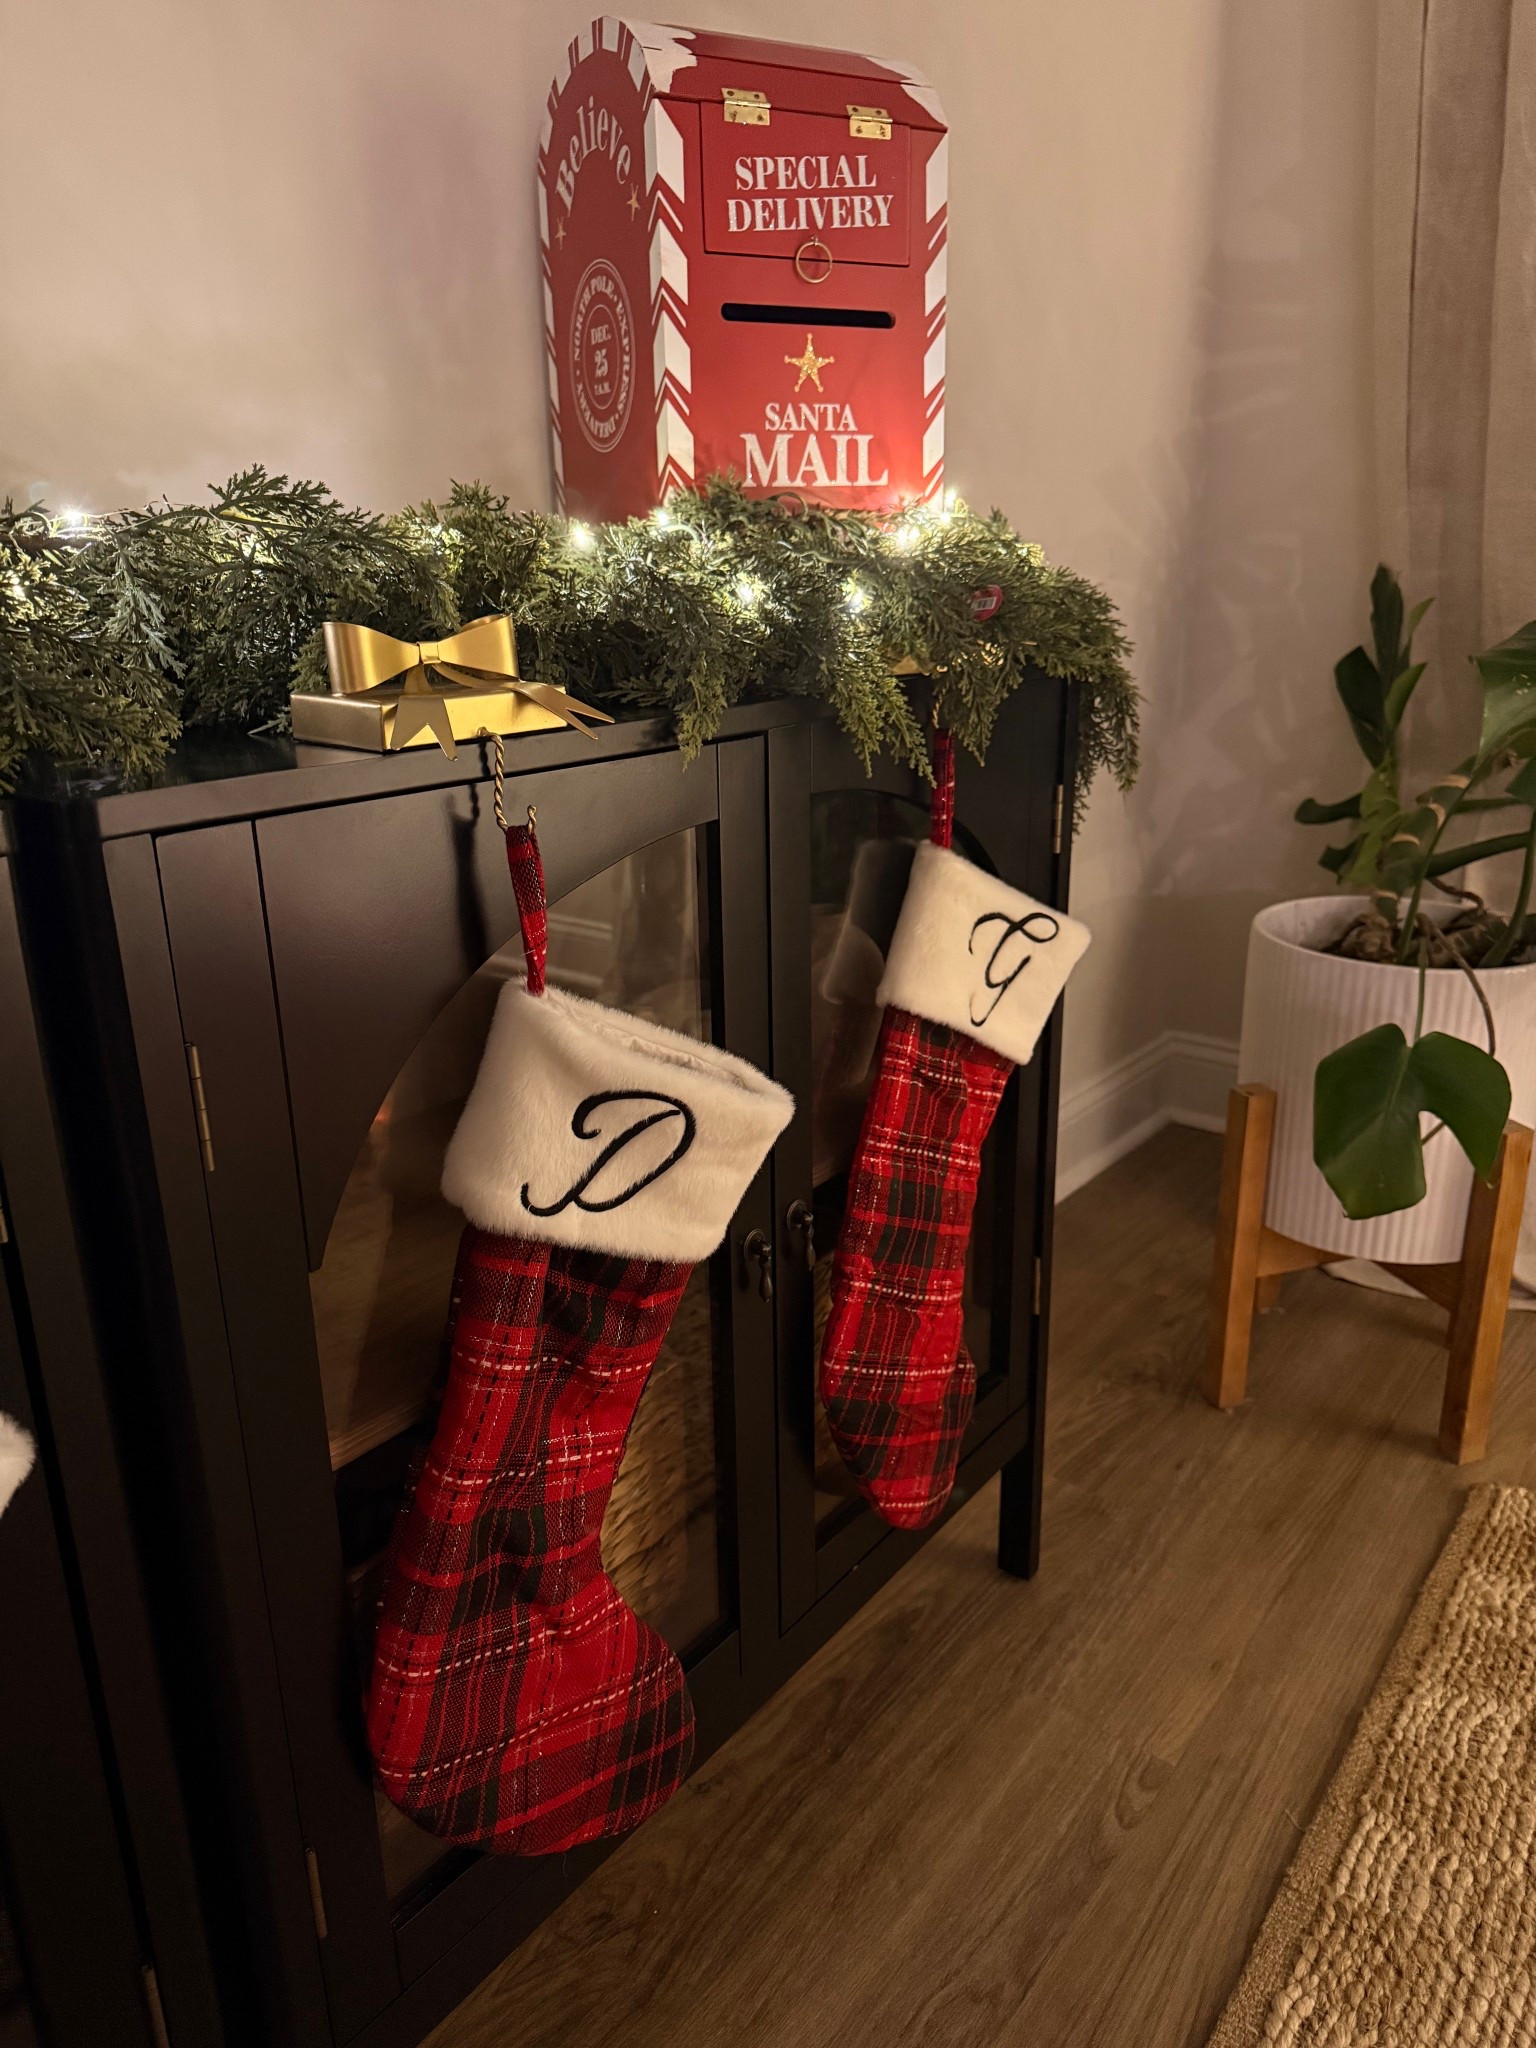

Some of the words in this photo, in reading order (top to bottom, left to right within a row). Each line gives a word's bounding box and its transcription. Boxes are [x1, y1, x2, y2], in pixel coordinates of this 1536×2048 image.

[555, 95, 631, 217] Believe
[735, 155, 877, 191] SPECIAL
[727, 195, 894, 232] DELIVERY
[591, 324, 612, 345] DEC.
[594, 348, 609, 378] 25
[765, 402, 858, 431] SANTA
[740, 433, 889, 487] MAIL
[520, 1089, 696, 1217] D
